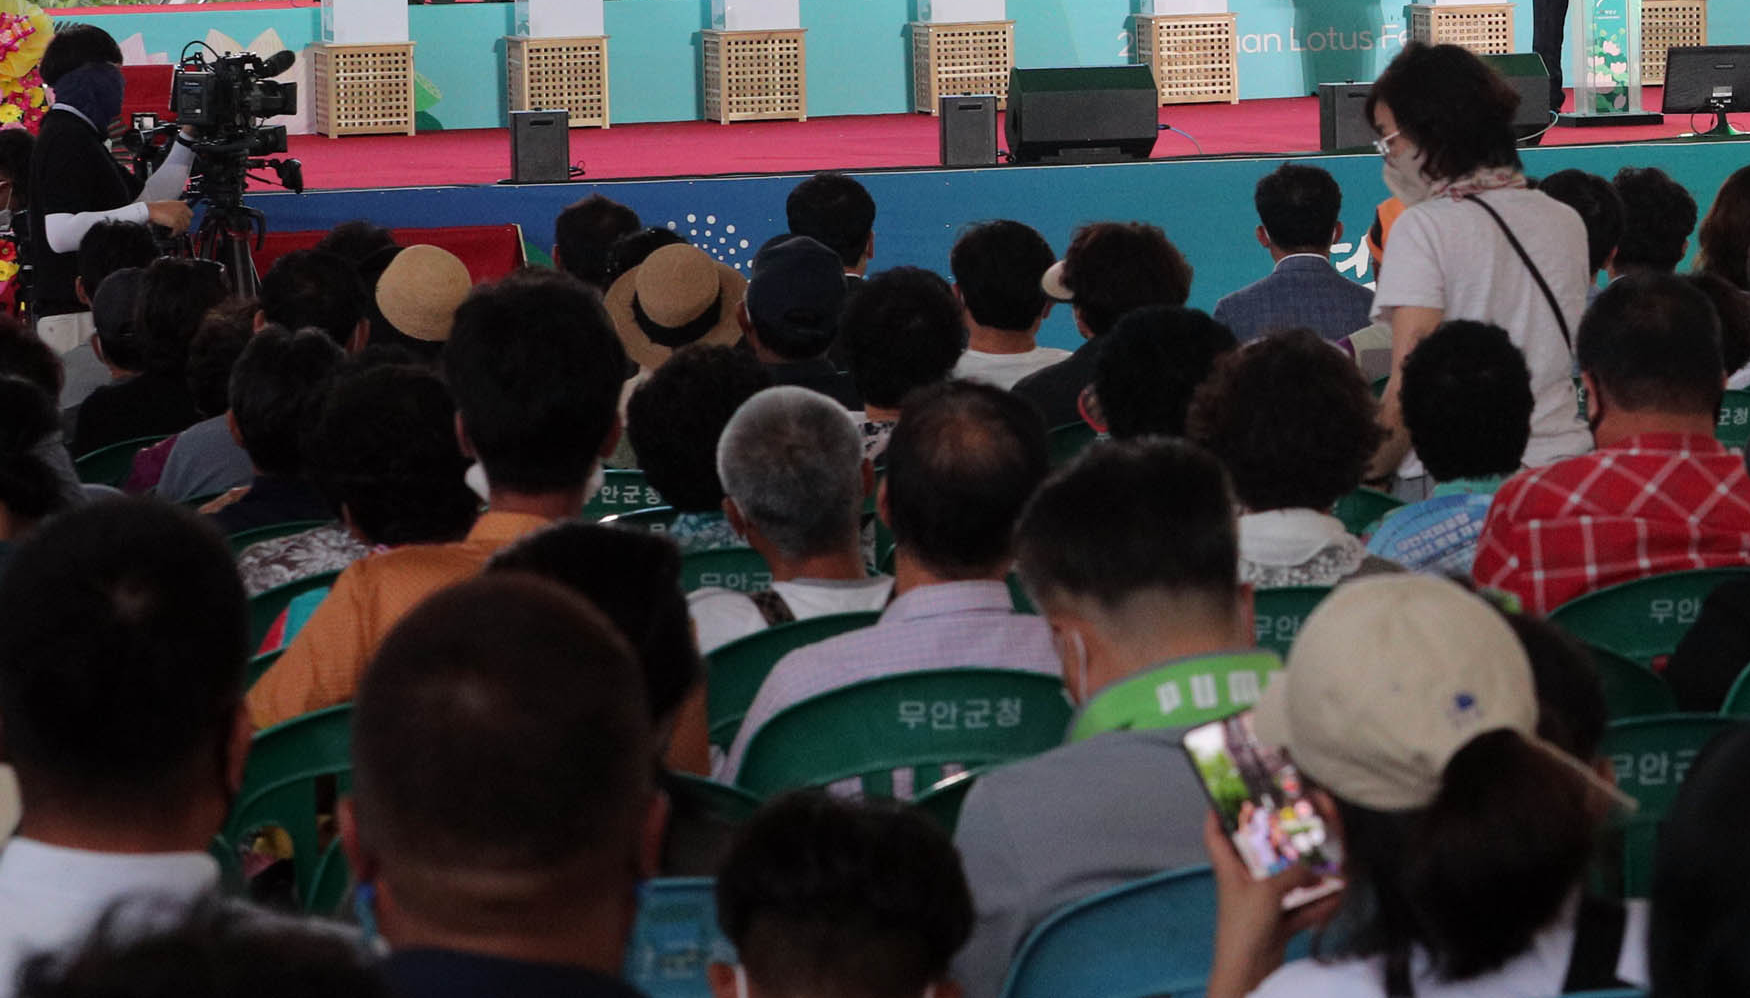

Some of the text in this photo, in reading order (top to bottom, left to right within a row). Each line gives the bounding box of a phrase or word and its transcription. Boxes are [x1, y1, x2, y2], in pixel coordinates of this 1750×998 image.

[1290, 26, 1375, 52] Lotus
[602, 485, 661, 505] 안군청
[1650, 598, 1703, 625] 무안
[898, 698, 1023, 730] 무안군청
